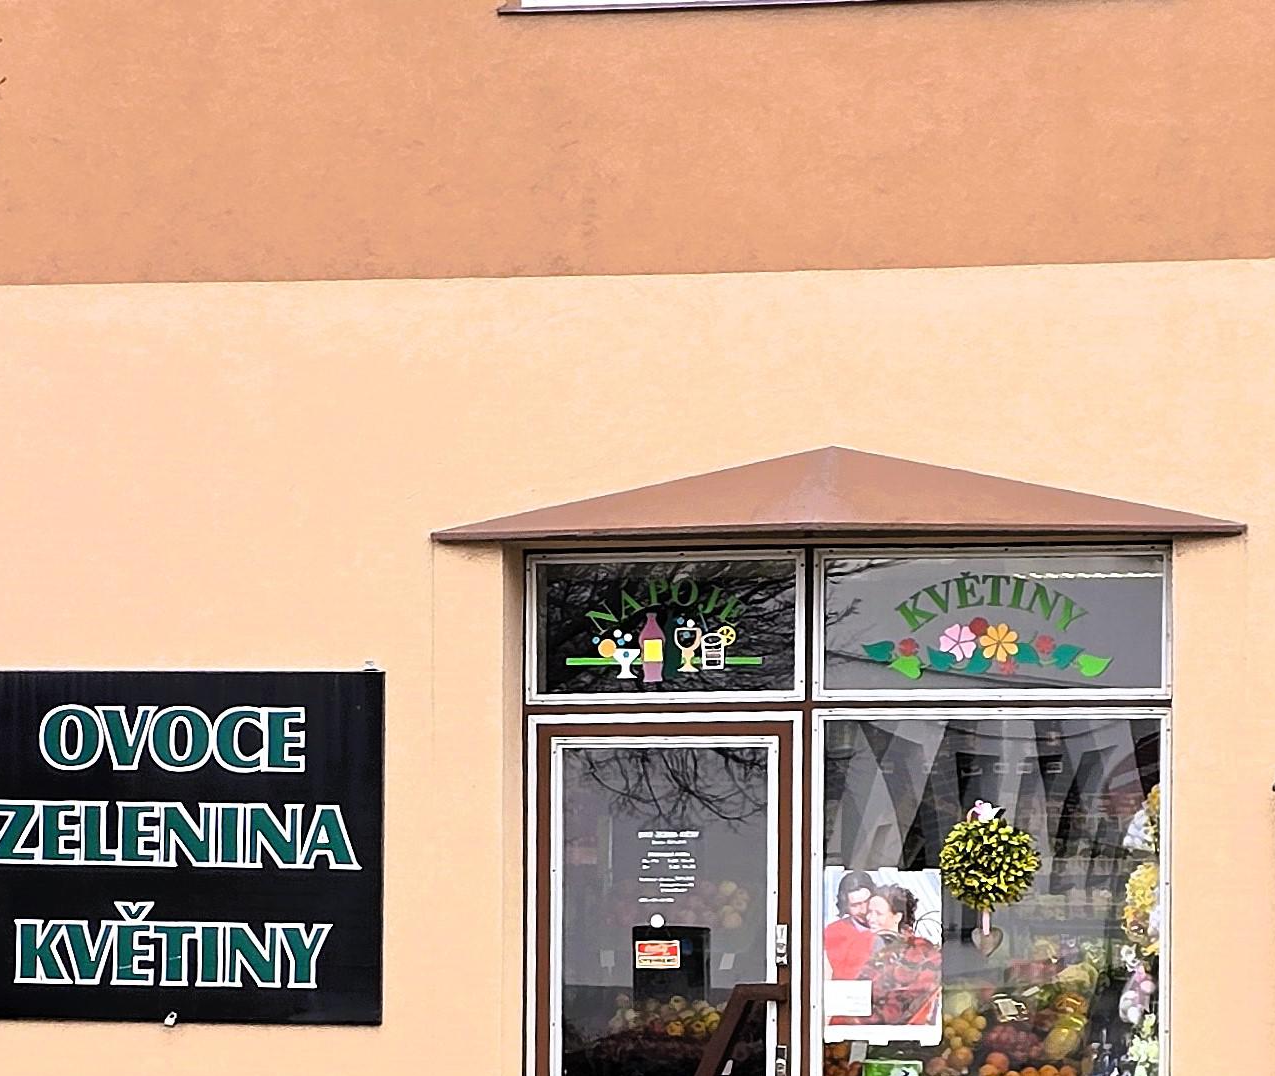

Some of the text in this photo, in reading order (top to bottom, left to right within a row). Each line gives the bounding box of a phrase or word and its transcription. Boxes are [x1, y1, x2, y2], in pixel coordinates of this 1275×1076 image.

[894, 571, 1089, 633] KVĚTINY
[38, 703, 306, 774] OVOCE
[13, 901, 333, 989] KVĚTINY
